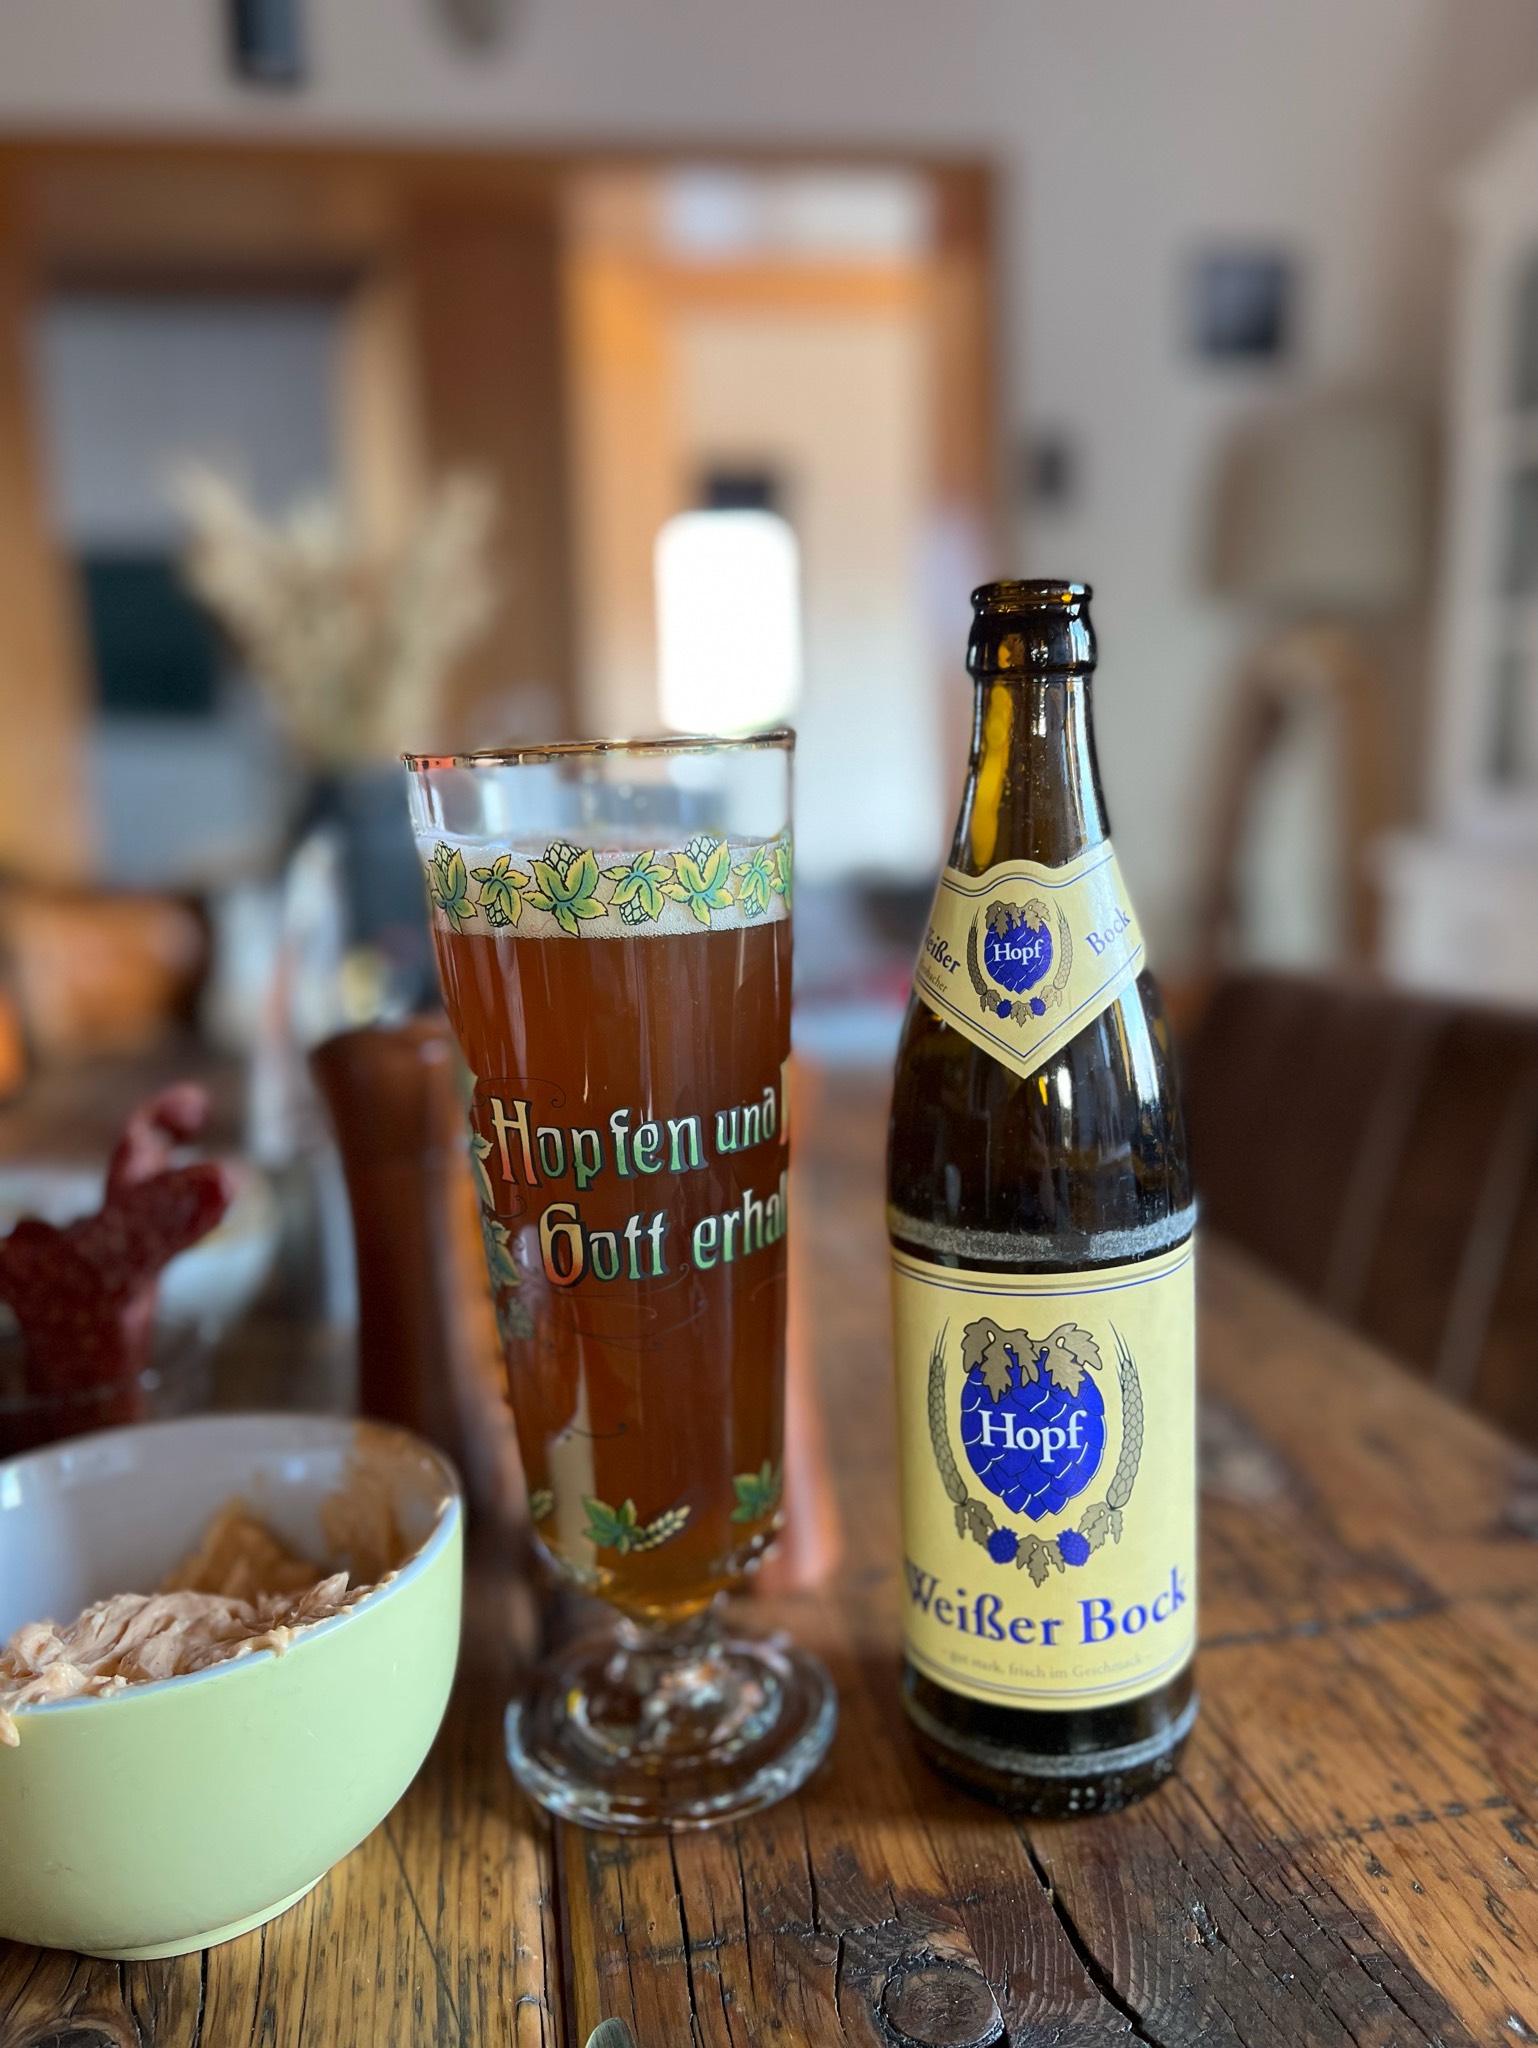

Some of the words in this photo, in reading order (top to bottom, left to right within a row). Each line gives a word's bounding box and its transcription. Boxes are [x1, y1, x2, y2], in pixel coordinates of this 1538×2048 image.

[927, 927, 961, 975] eißer
[1084, 907, 1131, 957] Bock
[993, 938, 1044, 965] Hopf
[489, 1096, 706, 1191] Hopfen
[715, 1085, 777, 1155] und
[538, 1203, 669, 1287] Gott
[978, 1409, 1087, 1463] Hopf
[904, 1557, 1063, 1646] Weißer
[1077, 1565, 1187, 1645] Bock
[1009, 1661, 1046, 1679] frisch
[1049, 1665, 1068, 1679] im
